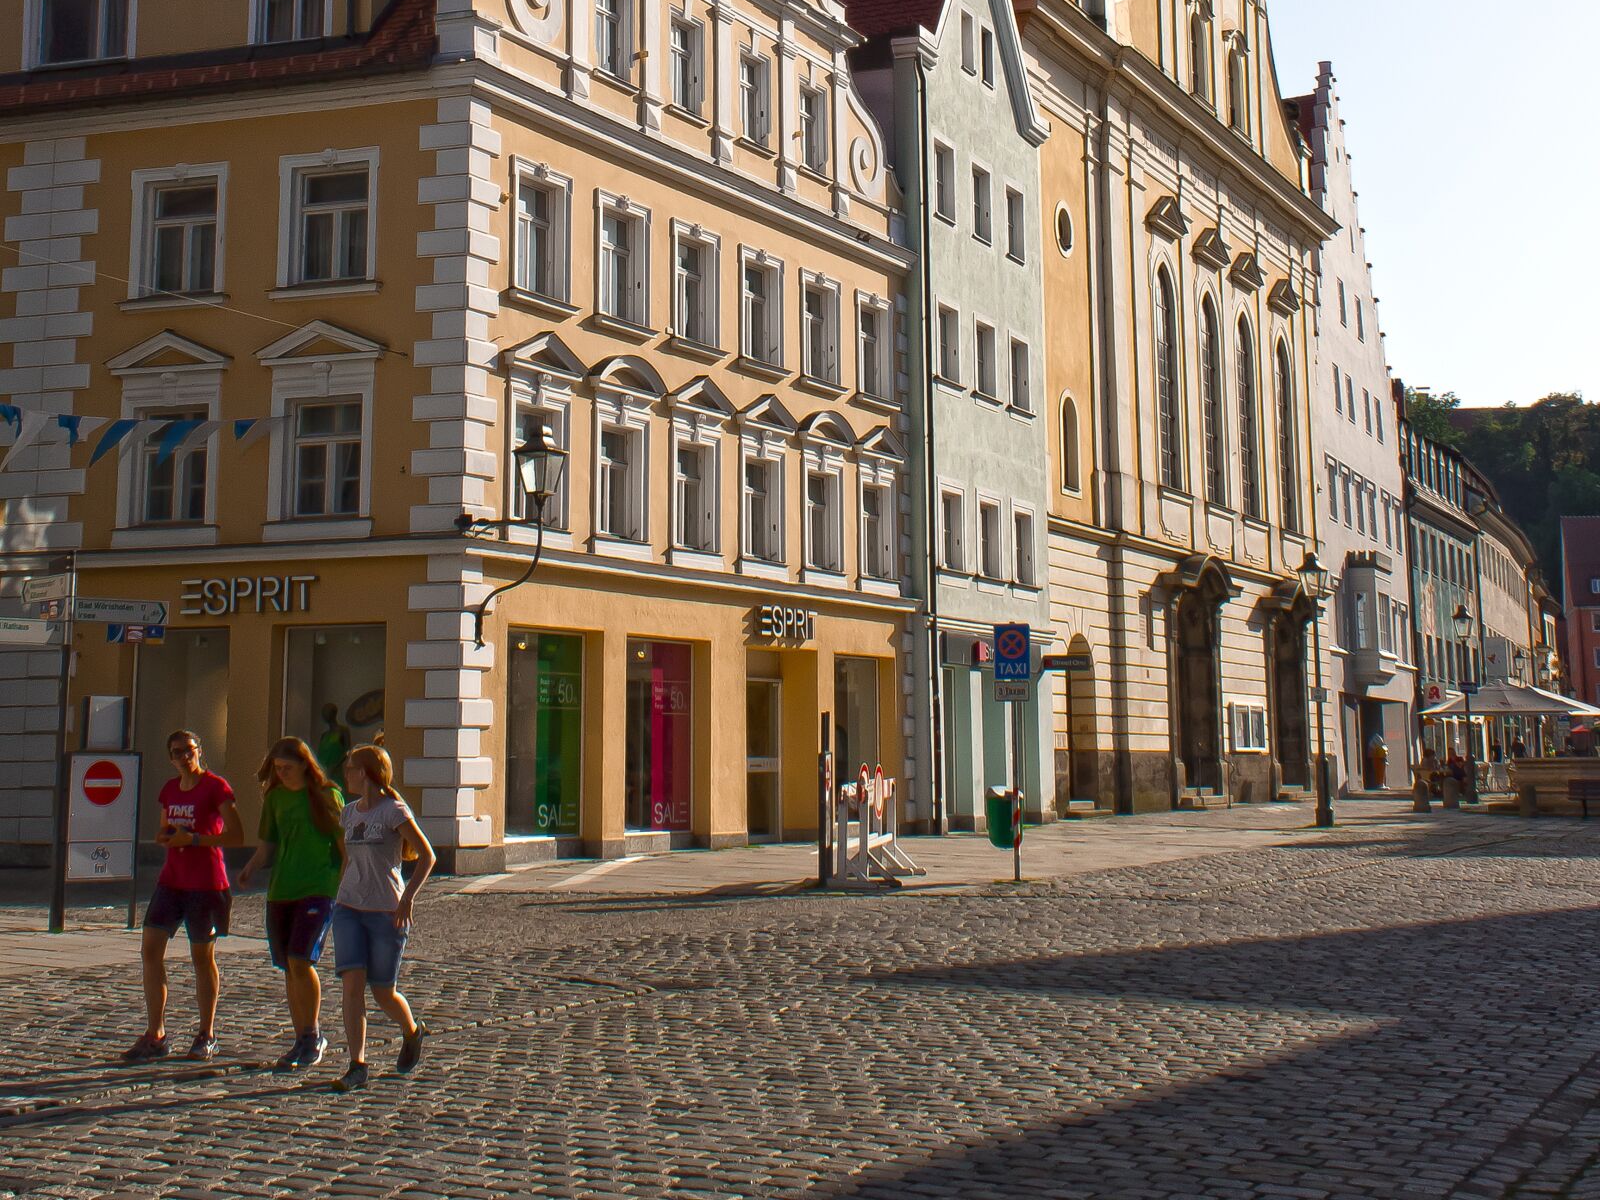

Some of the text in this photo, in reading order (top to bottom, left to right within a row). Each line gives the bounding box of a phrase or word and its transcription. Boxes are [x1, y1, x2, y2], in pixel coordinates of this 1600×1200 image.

[180, 575, 316, 615] ESPRIT
[78, 601, 93, 609] Bad
[3, 623, 30, 631] Rathaus
[761, 605, 818, 640] ESPRIT
[998, 662, 1027, 675] TAXI
[168, 804, 195, 817] TAKE
[538, 803, 577, 828] SALE
[654, 802, 688, 825] SALE
